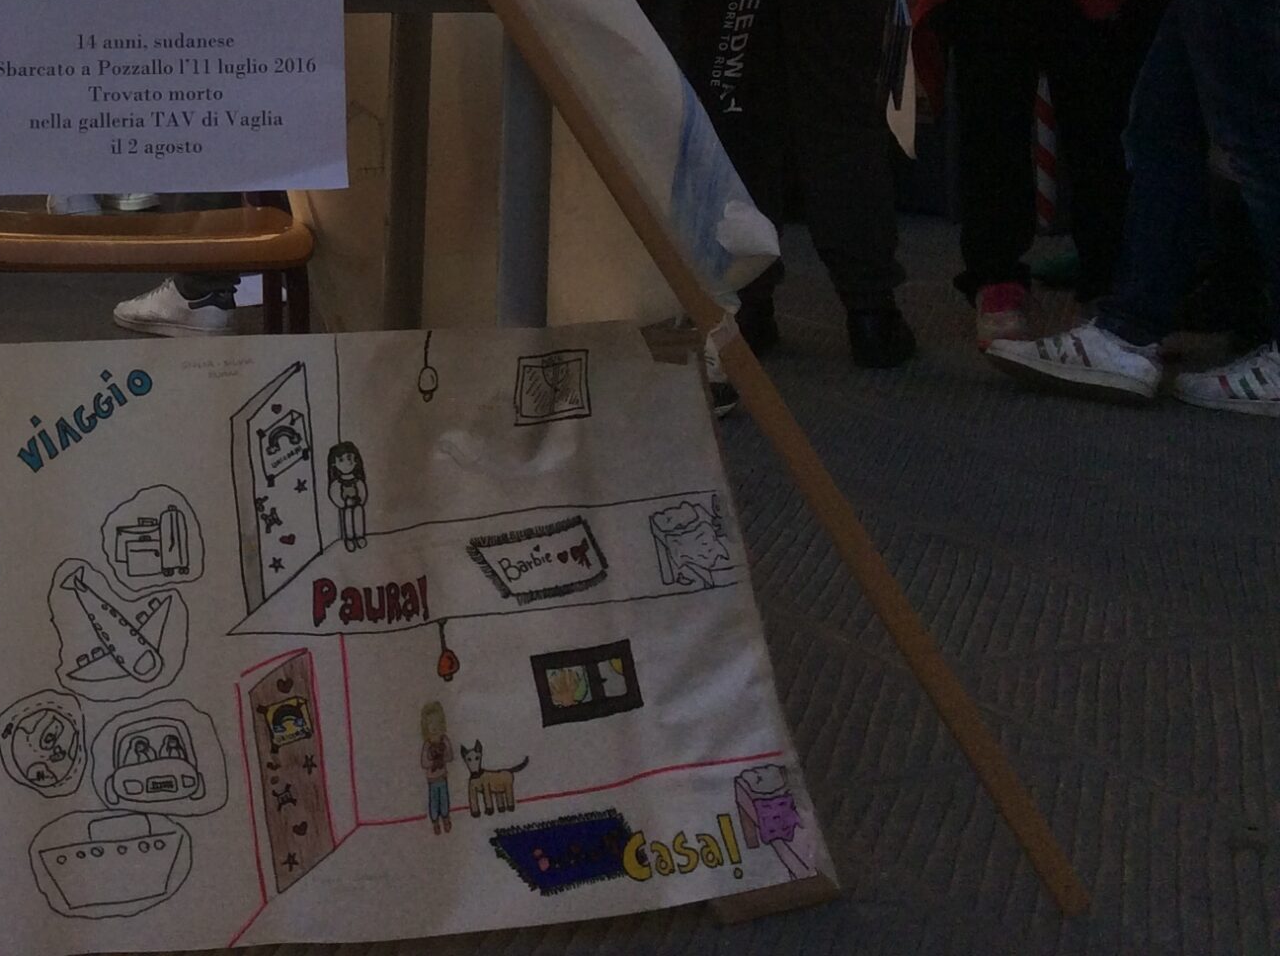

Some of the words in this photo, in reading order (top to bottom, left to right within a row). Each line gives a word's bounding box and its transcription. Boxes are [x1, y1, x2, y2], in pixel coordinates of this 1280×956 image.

[76, 33, 98, 51] 14
[102, 33, 149, 52] anni,
[153, 32, 235, 51] sudanese
[718, 32, 731, 52] TO
[80, 64, 92, 77] a
[97, 59, 174, 77] Pozzallo
[217, 57, 269, 79] luglio
[273, 57, 317, 75] 2016
[710, 54, 726, 89] RIDE
[87, 85, 164, 103] Trovato
[168, 86, 225, 102] morto
[28, 113, 73, 131] nella
[77, 111, 146, 134] galleria
[150, 111, 196, 128] TAV
[200, 110, 220, 128] di
[224, 109, 284, 132] Vaglia
[109, 138, 122, 156] il
[127, 138, 139, 155] 2
[143, 139, 204, 160] agosto
[497, 545, 552, 583] Barbie
[623, 813, 743, 881] Casa!
